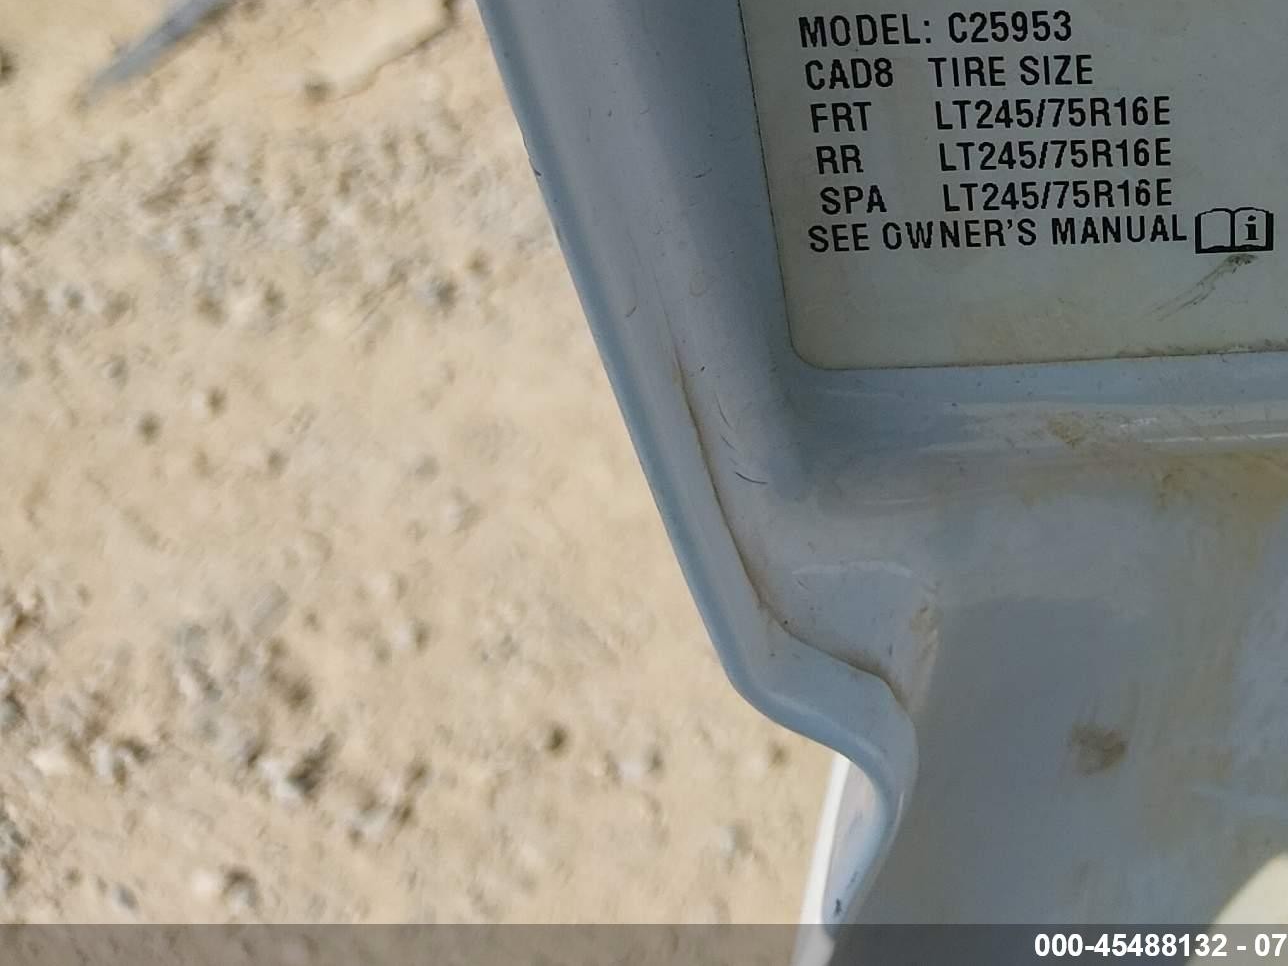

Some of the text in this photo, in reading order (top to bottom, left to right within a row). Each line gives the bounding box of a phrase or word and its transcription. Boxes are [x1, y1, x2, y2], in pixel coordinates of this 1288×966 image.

[799, 10, 1072, 48] MODEL: C25953
[805, 53, 1093, 90] CAD8 TIRE SIZE
[811, 101, 872, 133] FRT
[935, 96, 1171, 131] LT245/75R16E
[816, 145, 864, 175] RR
[939, 138, 1172, 172] LT245/75R16E
[821, 186, 887, 216] SPA
[943, 179, 1172, 213] LT245/75R16E
[808, 223, 870, 253] SEE
[883, 220, 1037, 250] OWNER'S
[1052, 216, 1187, 246] MANUAL
